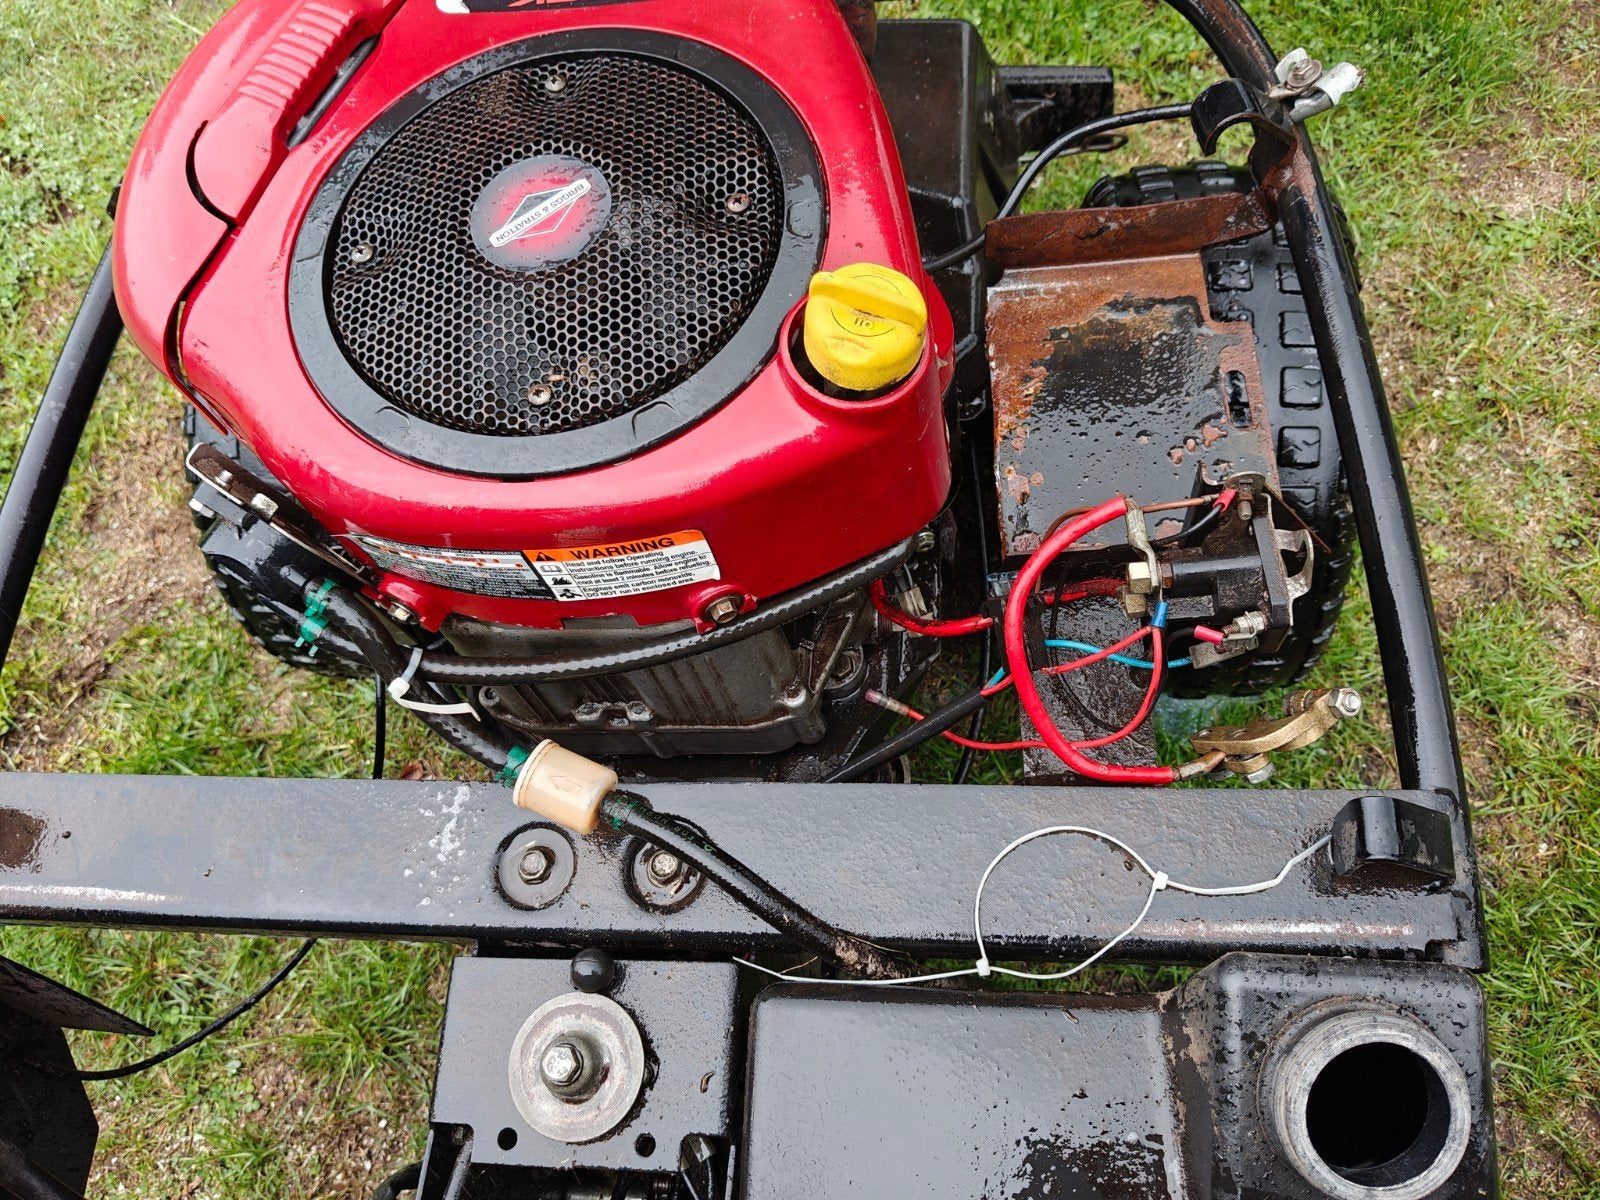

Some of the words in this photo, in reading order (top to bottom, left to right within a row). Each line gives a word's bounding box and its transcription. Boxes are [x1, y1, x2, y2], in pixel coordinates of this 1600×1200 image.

[550, 183, 585, 208] BRIGGS
[495, 211, 542, 242] STRATTON
[570, 537, 675, 560] WARNING
[602, 556, 625, 564] follow
[626, 551, 664, 561] Operating
[615, 560, 639, 569] before
[641, 556, 670, 564] running
[654, 562, 673, 570] Allow
[674, 556, 698, 566] engine
[626, 572, 655, 580] minutes
[655, 567, 678, 576] before
[583, 586, 613, 594] Engines
[614, 582, 630, 590] emit
[631, 579, 656, 588] carbon
[641, 581, 677, 591] enclosed
